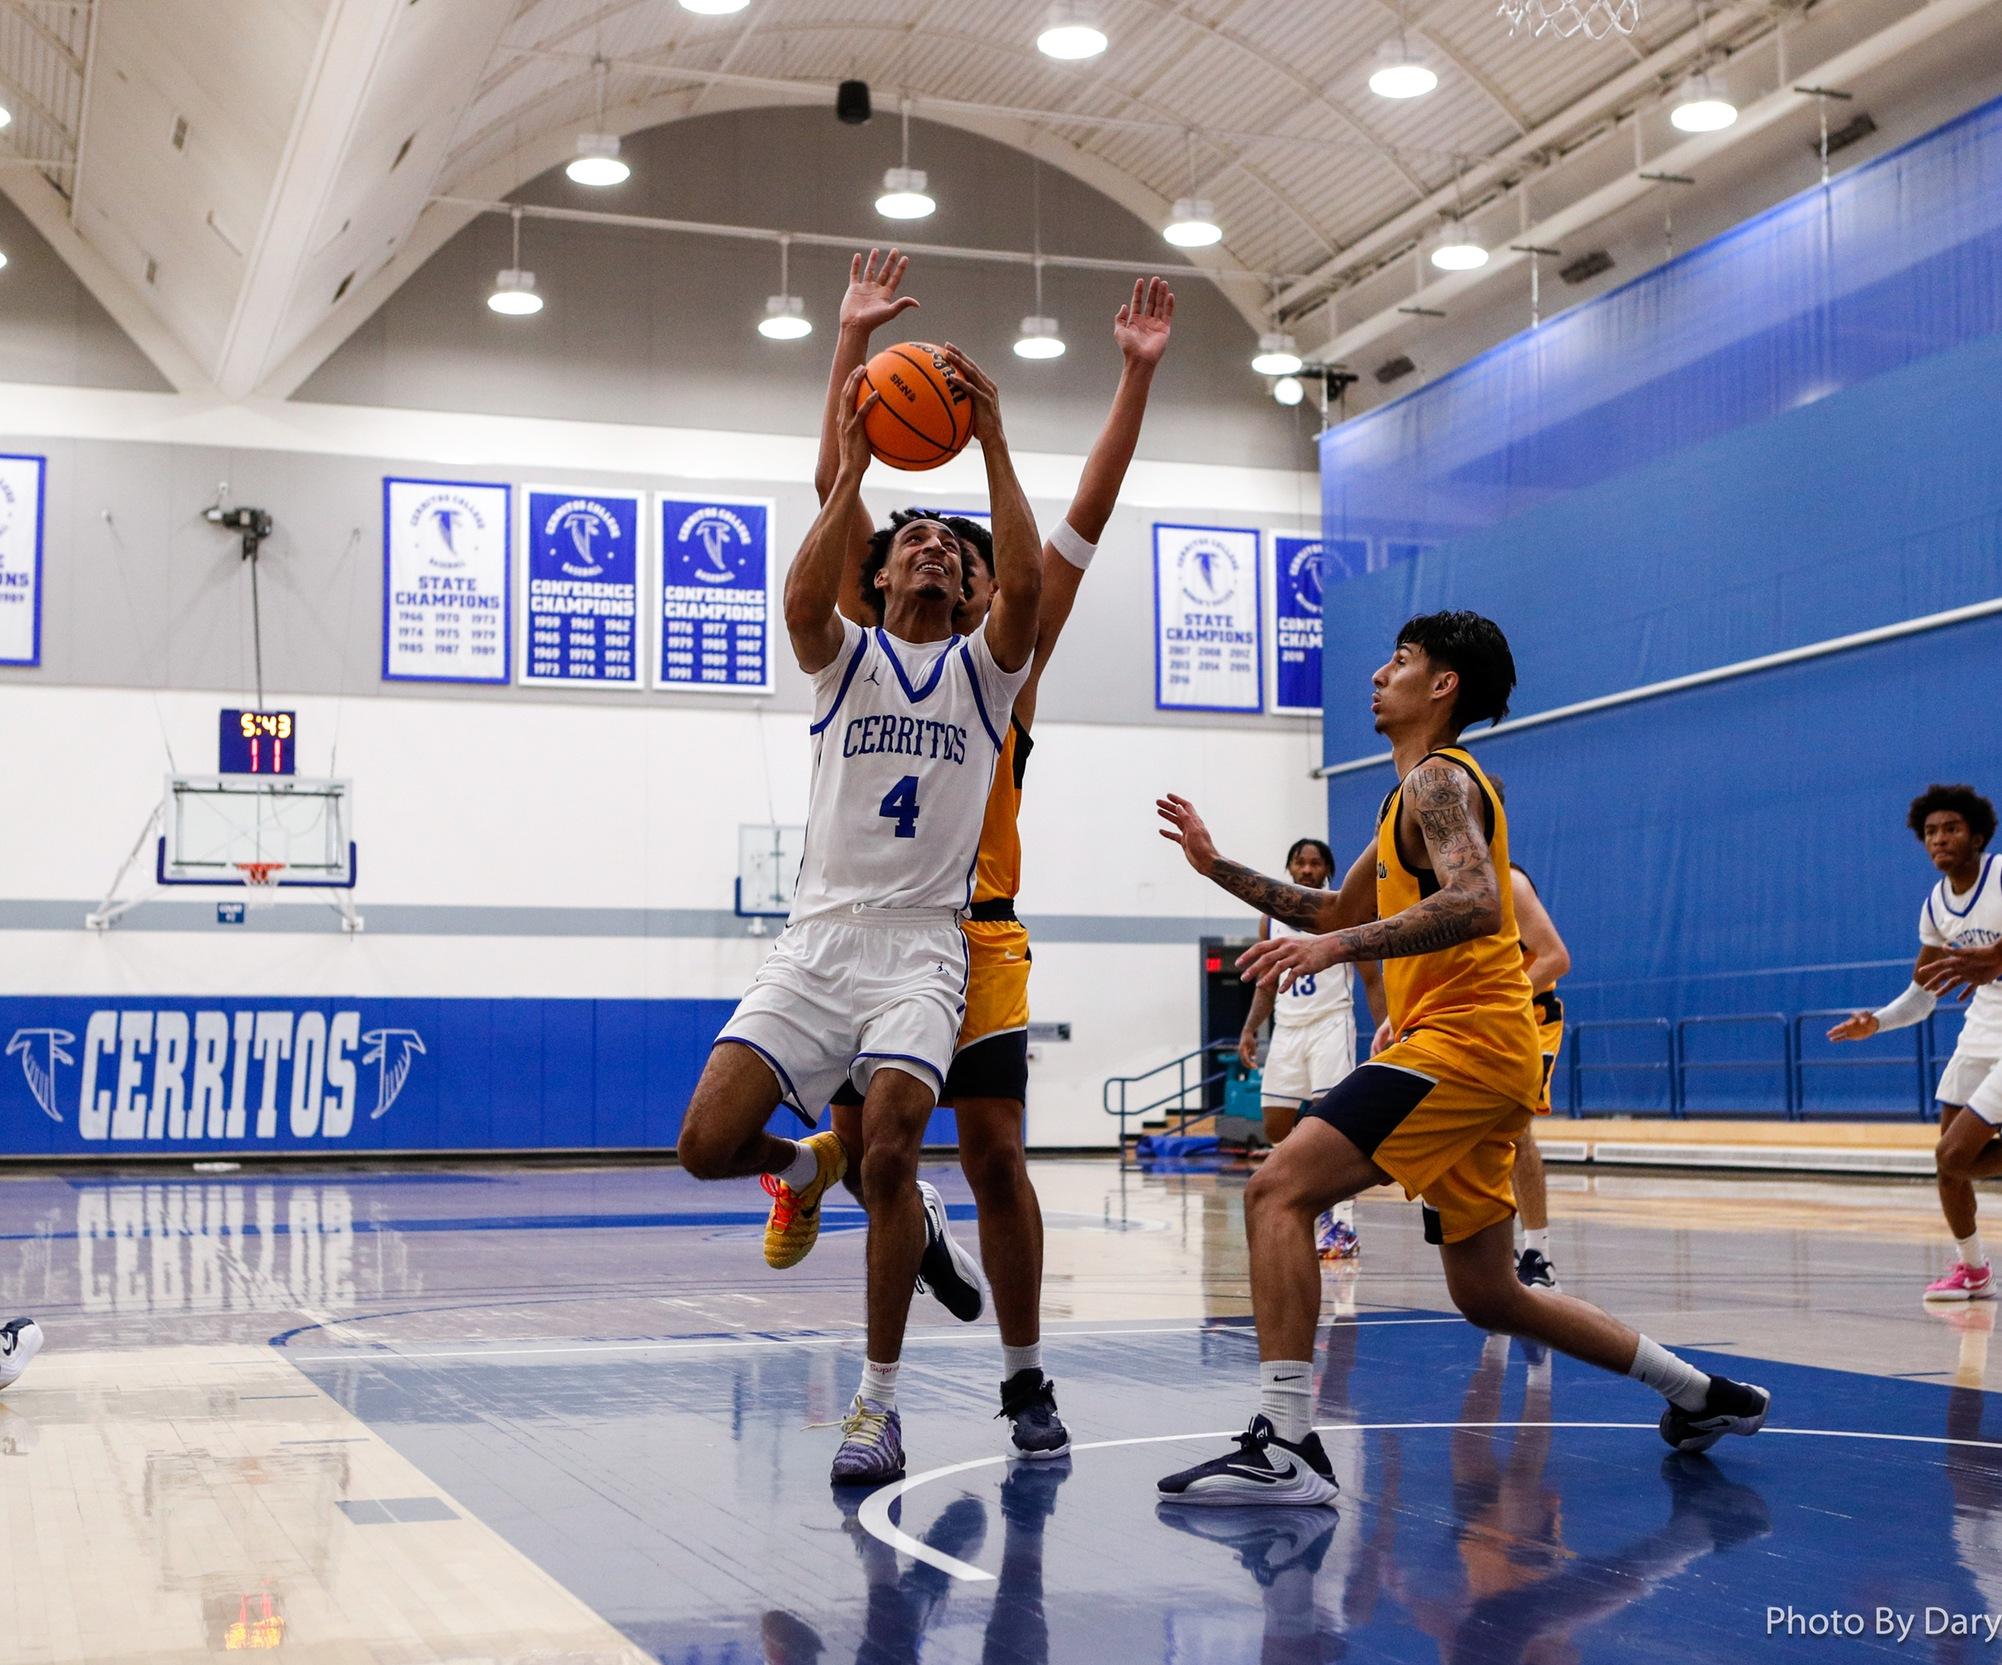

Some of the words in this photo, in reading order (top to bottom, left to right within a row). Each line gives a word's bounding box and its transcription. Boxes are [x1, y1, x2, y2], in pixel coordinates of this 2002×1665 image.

[889, 373, 913, 399] NFHS
[418, 576, 477, 591] STATE
[531, 579, 635, 599] CONFERENCE
[395, 592, 500, 609] CHAMPIONS
[664, 585, 765, 605] CONFERENCE
[531, 596, 635, 617] CHAMPIONS
[664, 602, 765, 622] CHAMPIONS
[1184, 613, 1234, 628] STATE
[1279, 617, 1323, 633] CONFE
[1166, 628, 1254, 644] CHAMPIONS
[1279, 632, 1323, 649] CHAM
[241, 712, 291, 739] 5:43
[842, 714, 967, 765] CERRITOS
[251, 738, 281, 773] 11
[879, 775, 920, 838] 4
[79, 1011, 361, 1140] CERRITOS
